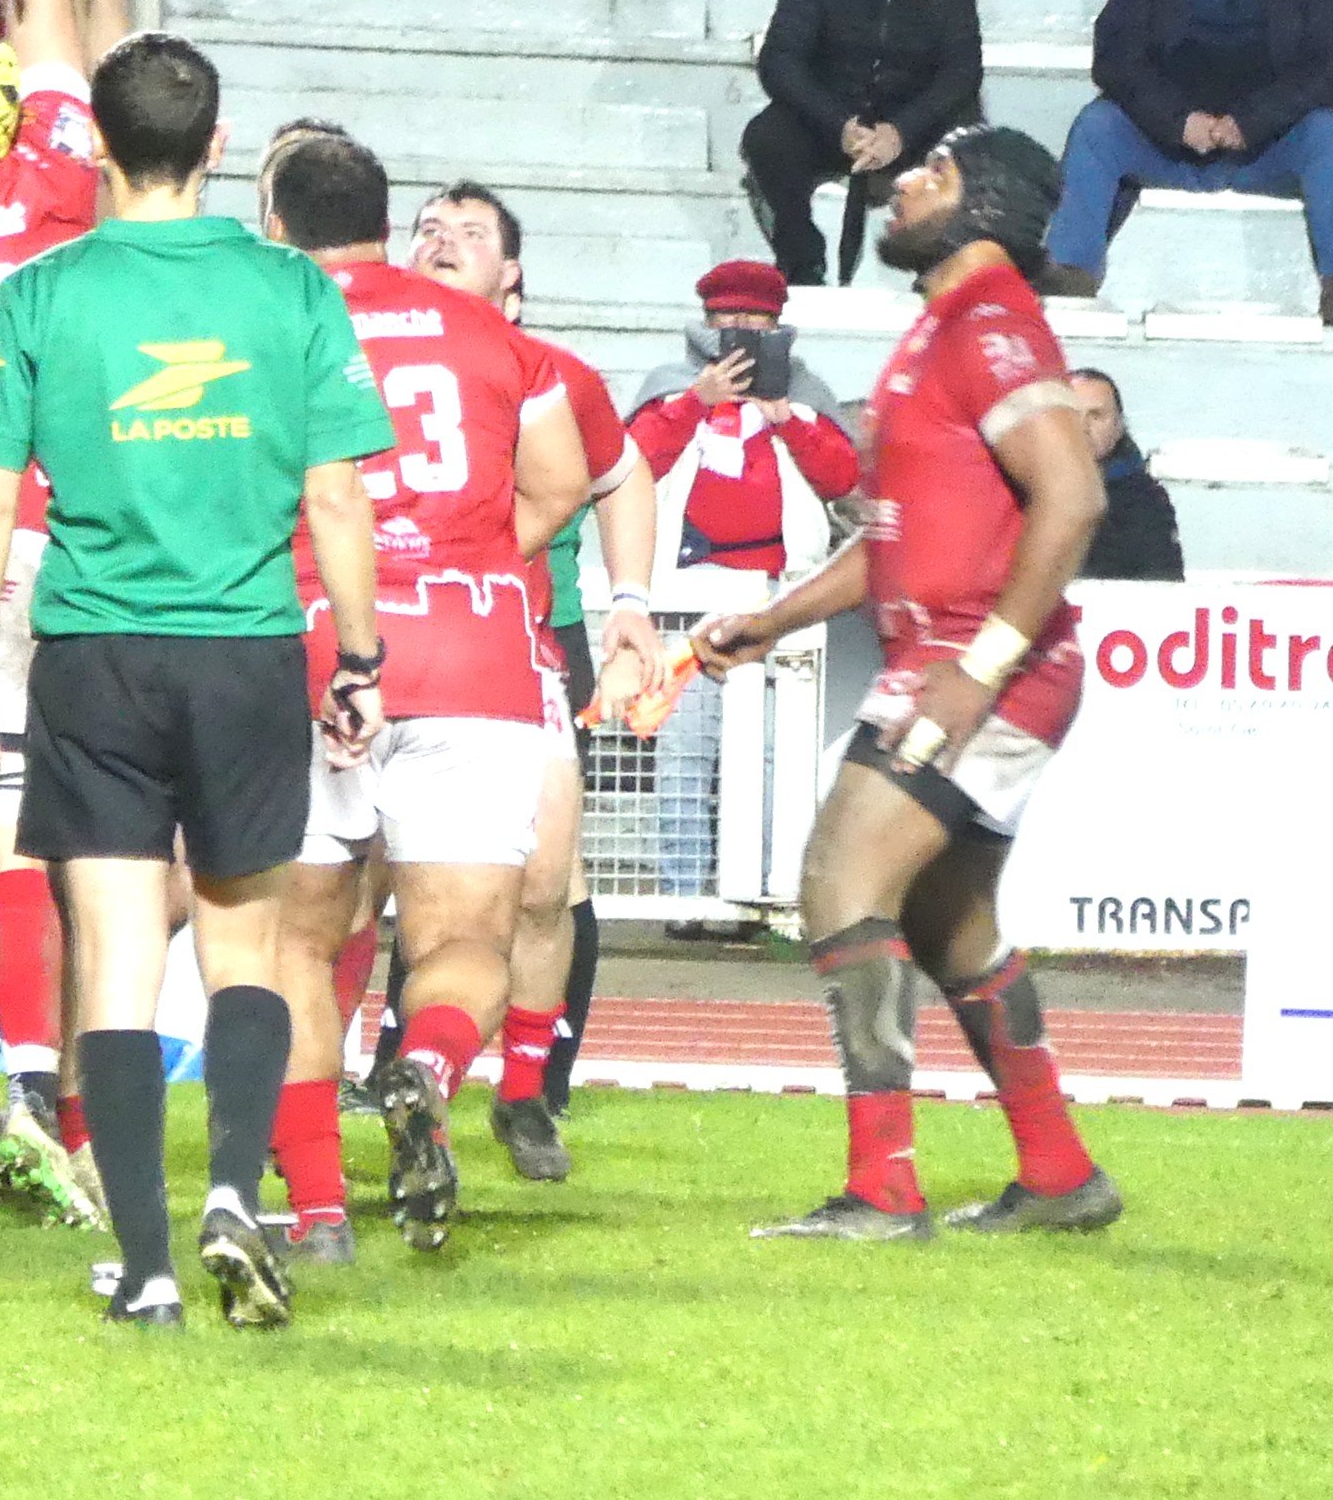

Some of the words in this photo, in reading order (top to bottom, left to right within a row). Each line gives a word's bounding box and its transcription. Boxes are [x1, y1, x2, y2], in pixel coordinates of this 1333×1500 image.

[110, 420, 151, 441] LA
[153, 416, 251, 441] POSTE
[1069, 896, 1251, 936] TRANSP
